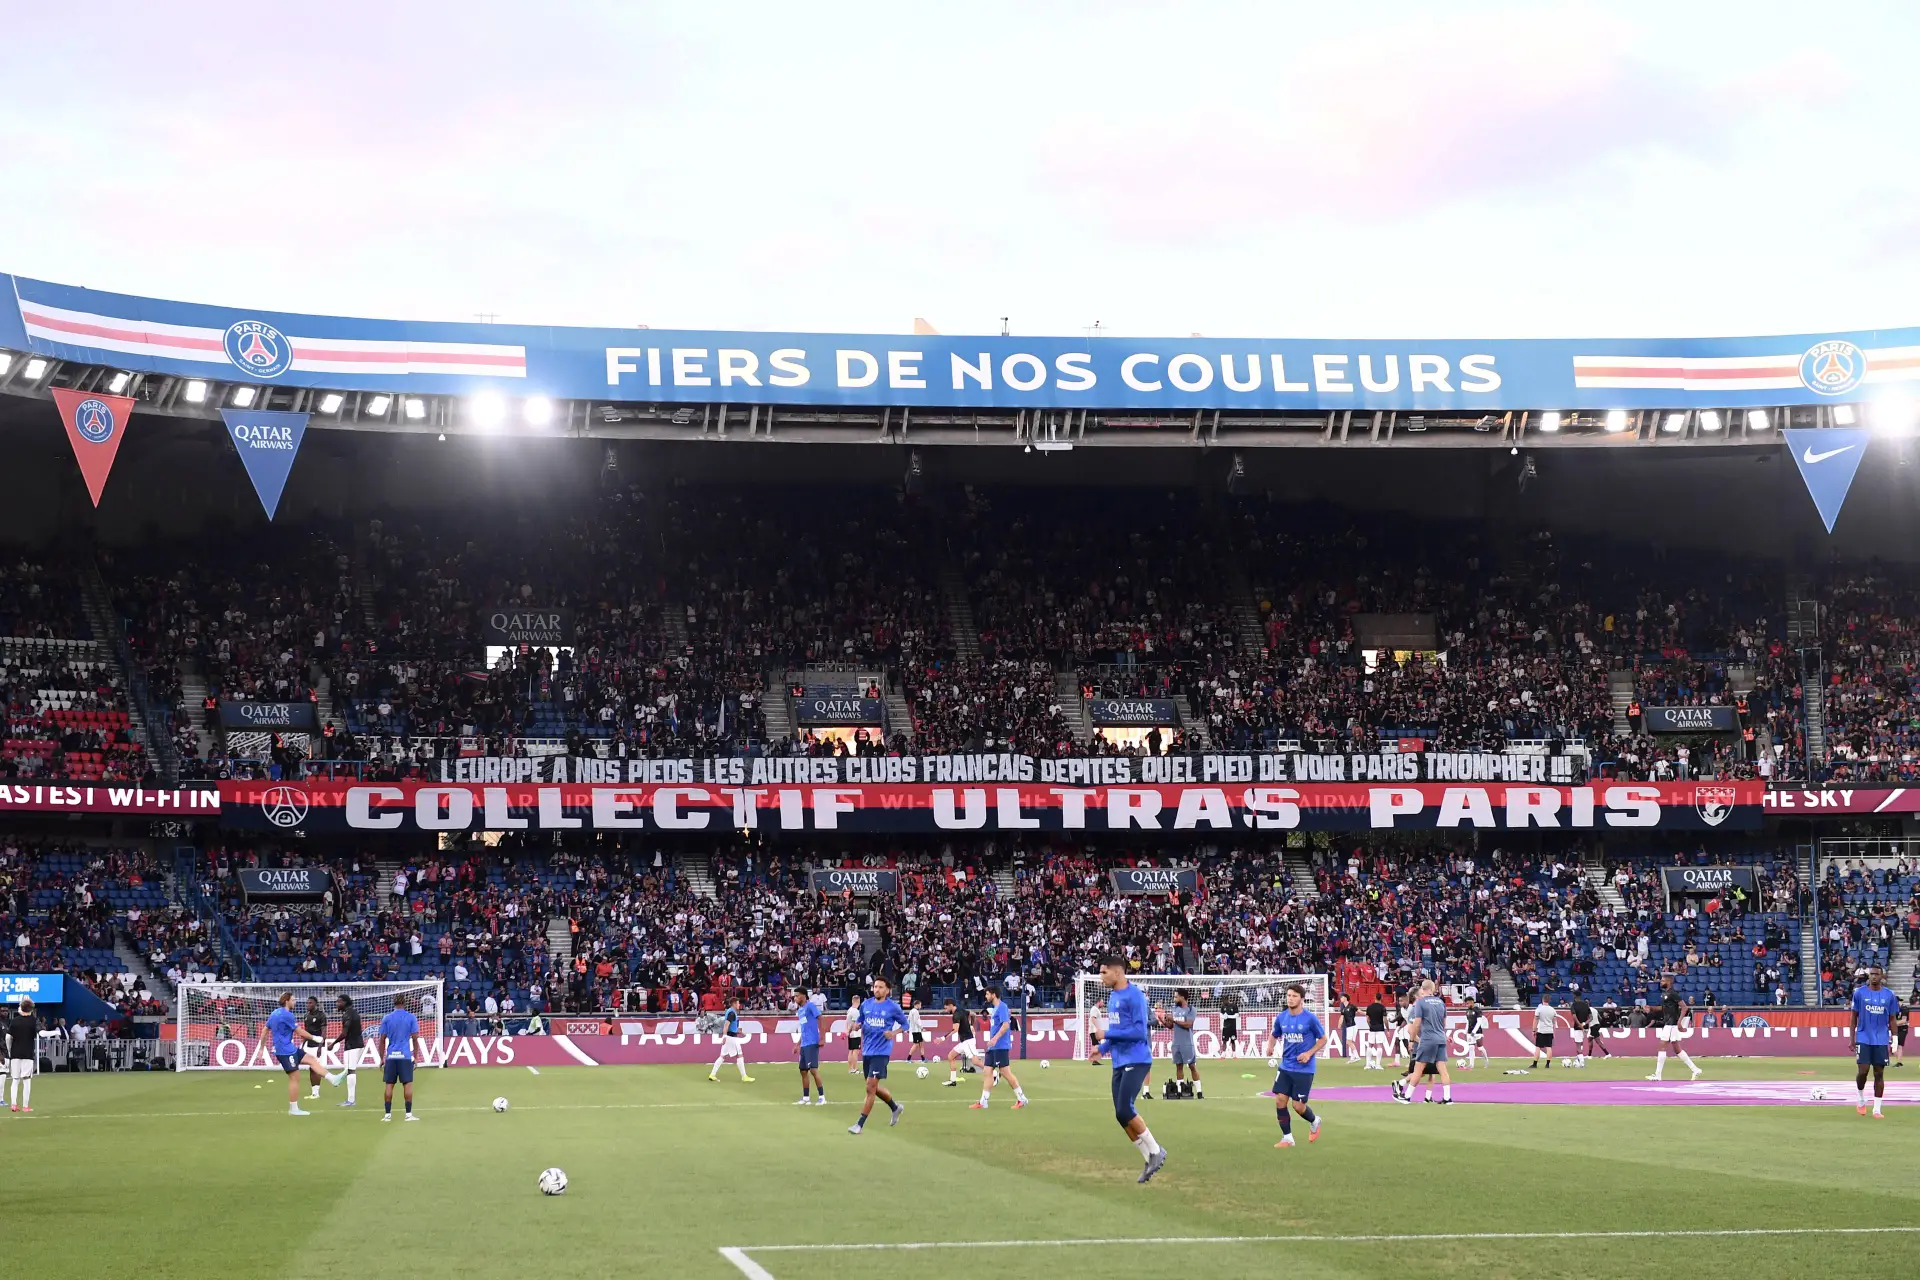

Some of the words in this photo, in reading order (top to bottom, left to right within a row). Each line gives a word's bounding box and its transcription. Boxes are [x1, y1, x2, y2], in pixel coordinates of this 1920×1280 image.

[234, 323, 278, 340] PARIS
[1811, 343, 1855, 359] PARIS
[605, 347, 811, 388] FIERS
[836, 349, 928, 390] DE
[950, 351, 1098, 392] NOS
[1120, 352, 1502, 393] COULEURS
[82, 401, 107, 414] PARIS
[234, 424, 293, 442] QATAR
[249, 439, 294, 450] AIRWAYS
[490, 613, 561, 633] QATAR
[508, 631, 562, 642] AIRWAYS
[240, 704, 290, 719] QATAR
[814, 700, 862, 714] QATAR
[1108, 702, 1154, 715] QATAR
[252, 717, 290, 725] AIRWAYS
[1664, 709, 1712, 722] QATAR
[1677, 720, 1713, 728] AIRWAYS
[440, 756, 545, 783] L'EUROPE
[551, 757, 568, 783] A
[575, 757, 621, 783] NOS
[628, 758, 694, 783] PIEDS
[703, 757, 745, 784] LES
[751, 757, 838, 784] AUTRES
[846, 756, 917, 783] CLUBS
[923, 753, 1034, 782] FRANCAIS
[1040, 757, 1137, 783] DEPITES.
[1141, 756, 1197, 783] QUEL
[1203, 754, 1253, 782] PIED
[1259, 753, 1287, 781] DE
[1293, 753, 1346, 781] VOIR
[1352, 752, 1418, 781] PARIS
[1425, 752, 1546, 782] TRIOMPHER
[190, 789, 221, 808] IN
[1803, 789, 1854, 808] SKY
[345, 786, 863, 830] COLLECTIF
[931, 787, 1301, 829] ULTRAS
[1368, 786, 1661, 829] PARIS
[258, 870, 310, 885] QATAR
[830, 871, 878, 885] QATAR
[1130, 870, 1179, 884] QATAR
[1683, 870, 1733, 885] QATAR
[271, 883, 310, 891] AIRWAYS
[842, 883, 879, 891] ARWAYS
[357, 1036, 515, 1065] AWAYS
[288, 1055, 295, 1064] 6
